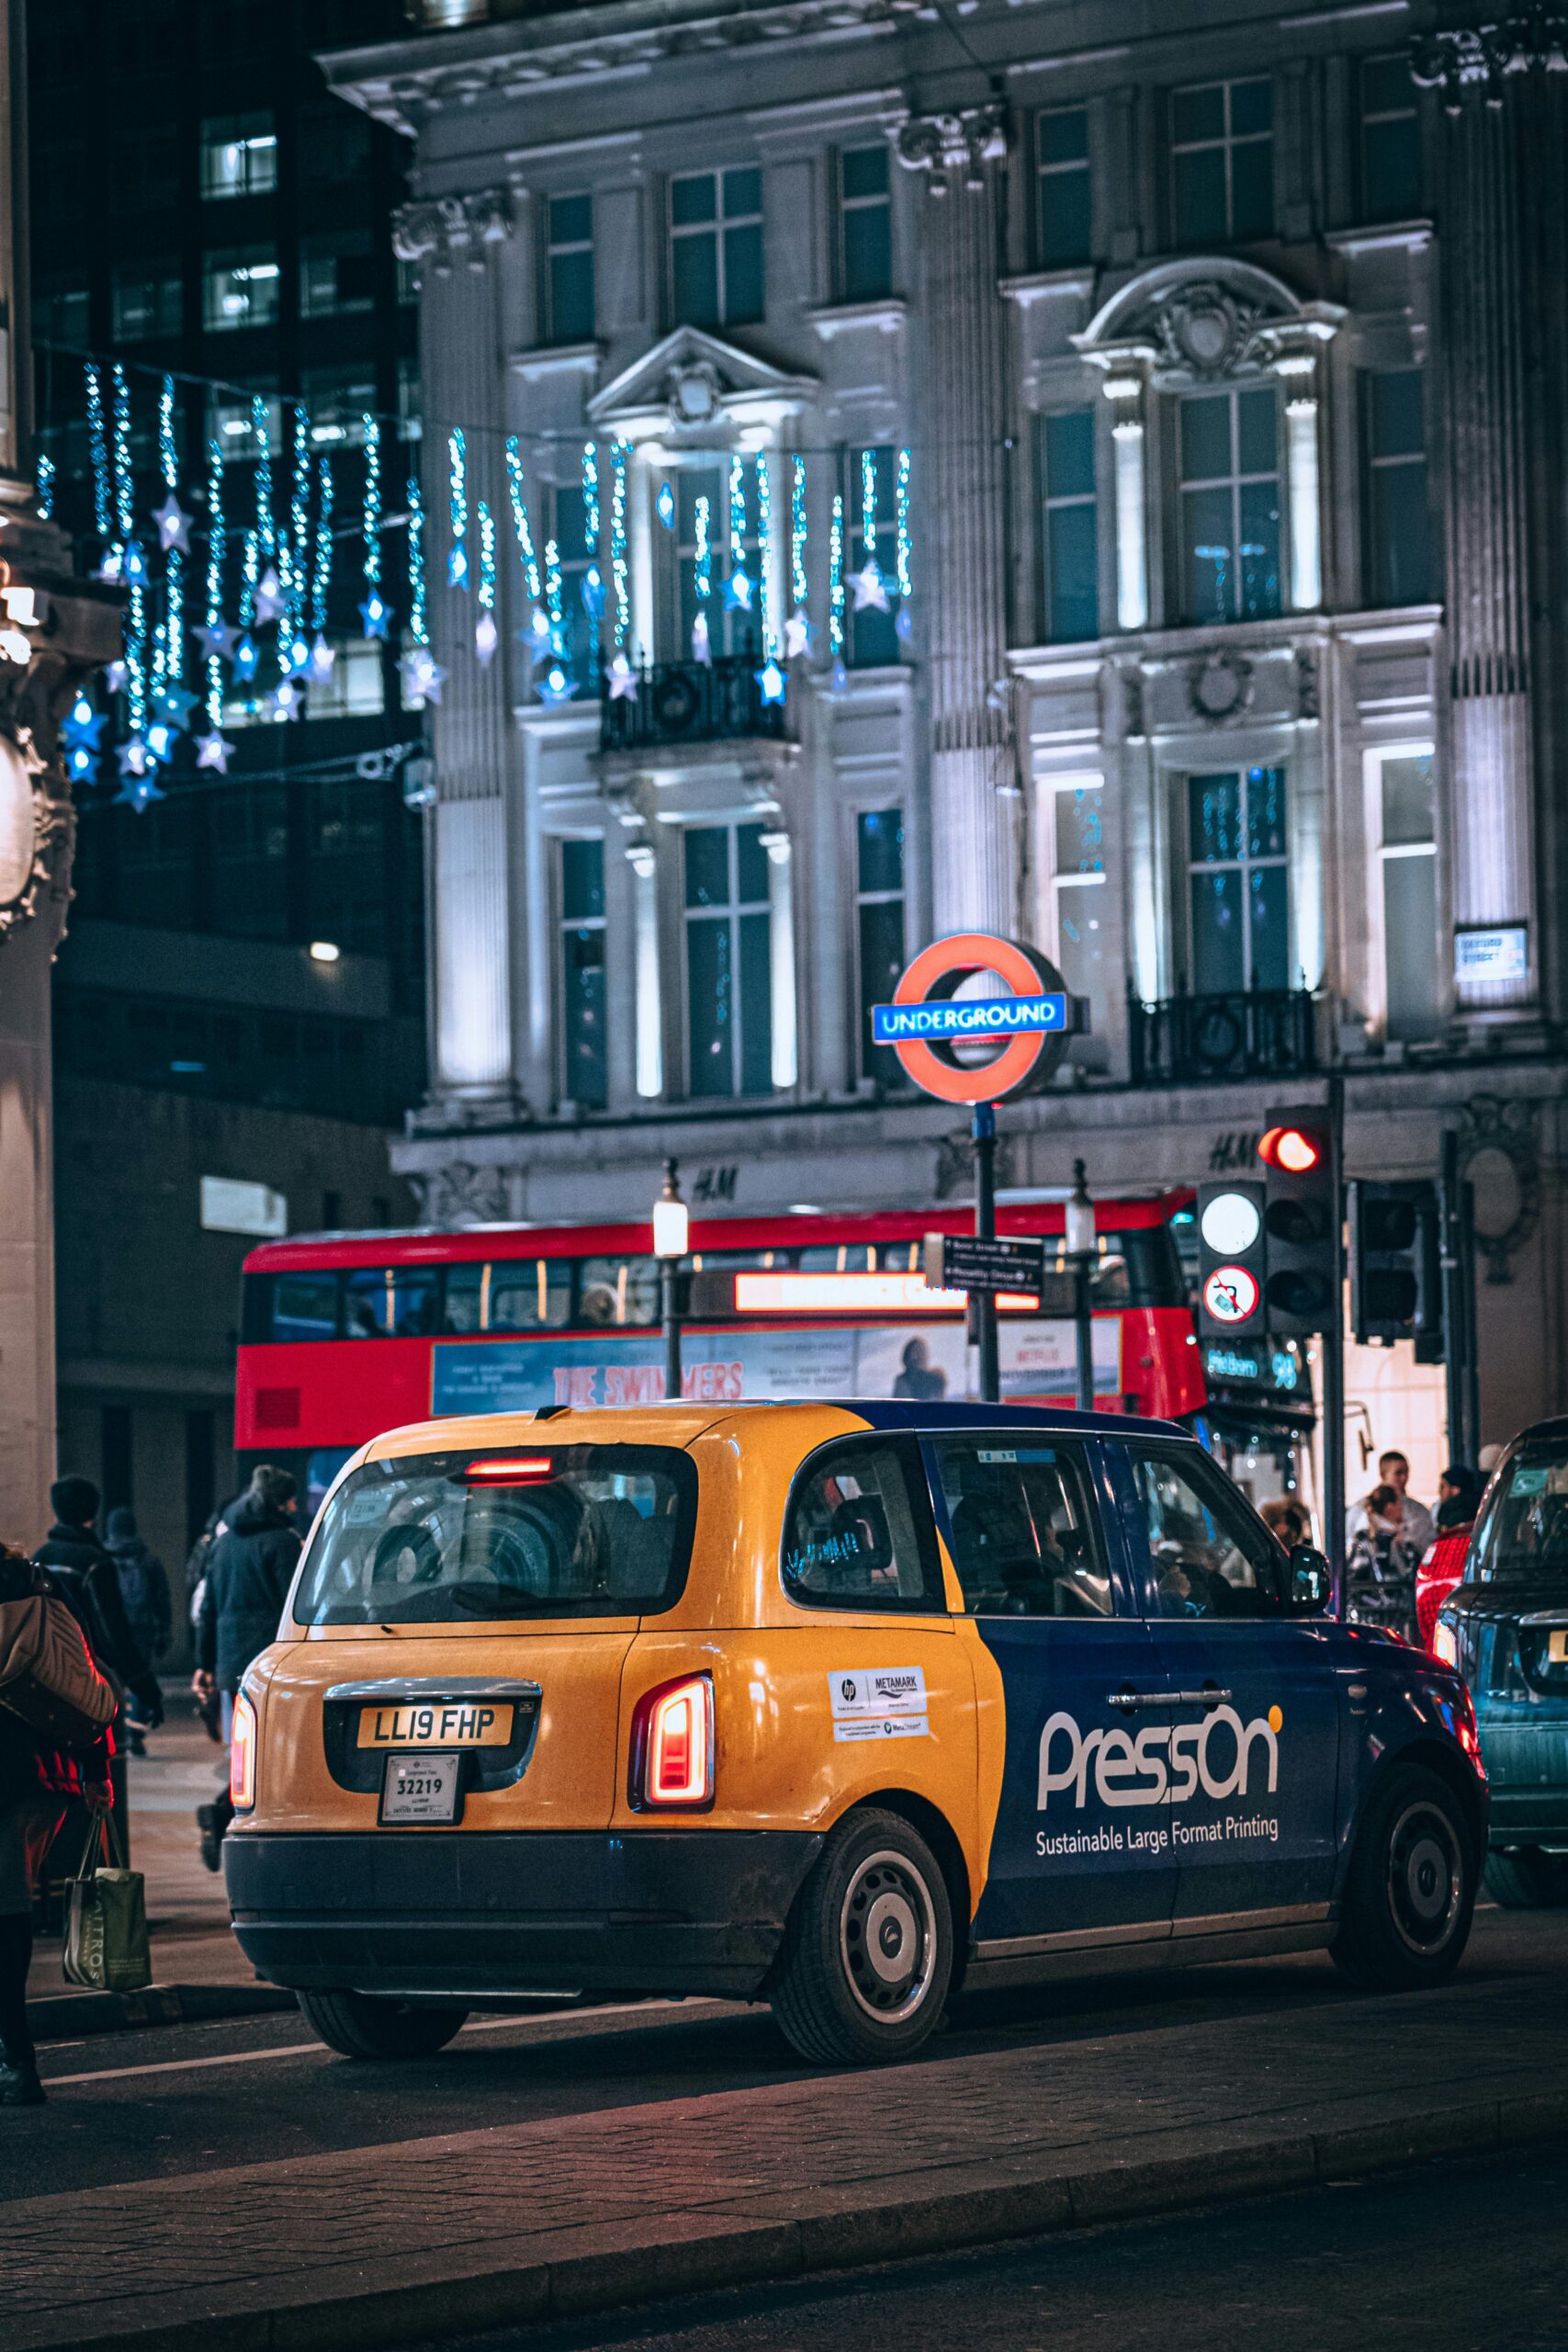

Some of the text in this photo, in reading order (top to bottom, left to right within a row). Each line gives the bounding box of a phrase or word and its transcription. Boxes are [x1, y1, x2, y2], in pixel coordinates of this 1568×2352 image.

[883, 1002, 1055, 1033] UNDERGROUND
[553, 1366, 597, 1407] THE
[842, 1679, 856, 1702] hp
[875, 1676, 917, 1689] METAMARK
[374, 1709, 495, 1741] LL19 FHP
[397, 1778, 443, 1795] 32219
[1036, 1814, 1279, 1856] Sustainable Large Format Printing
